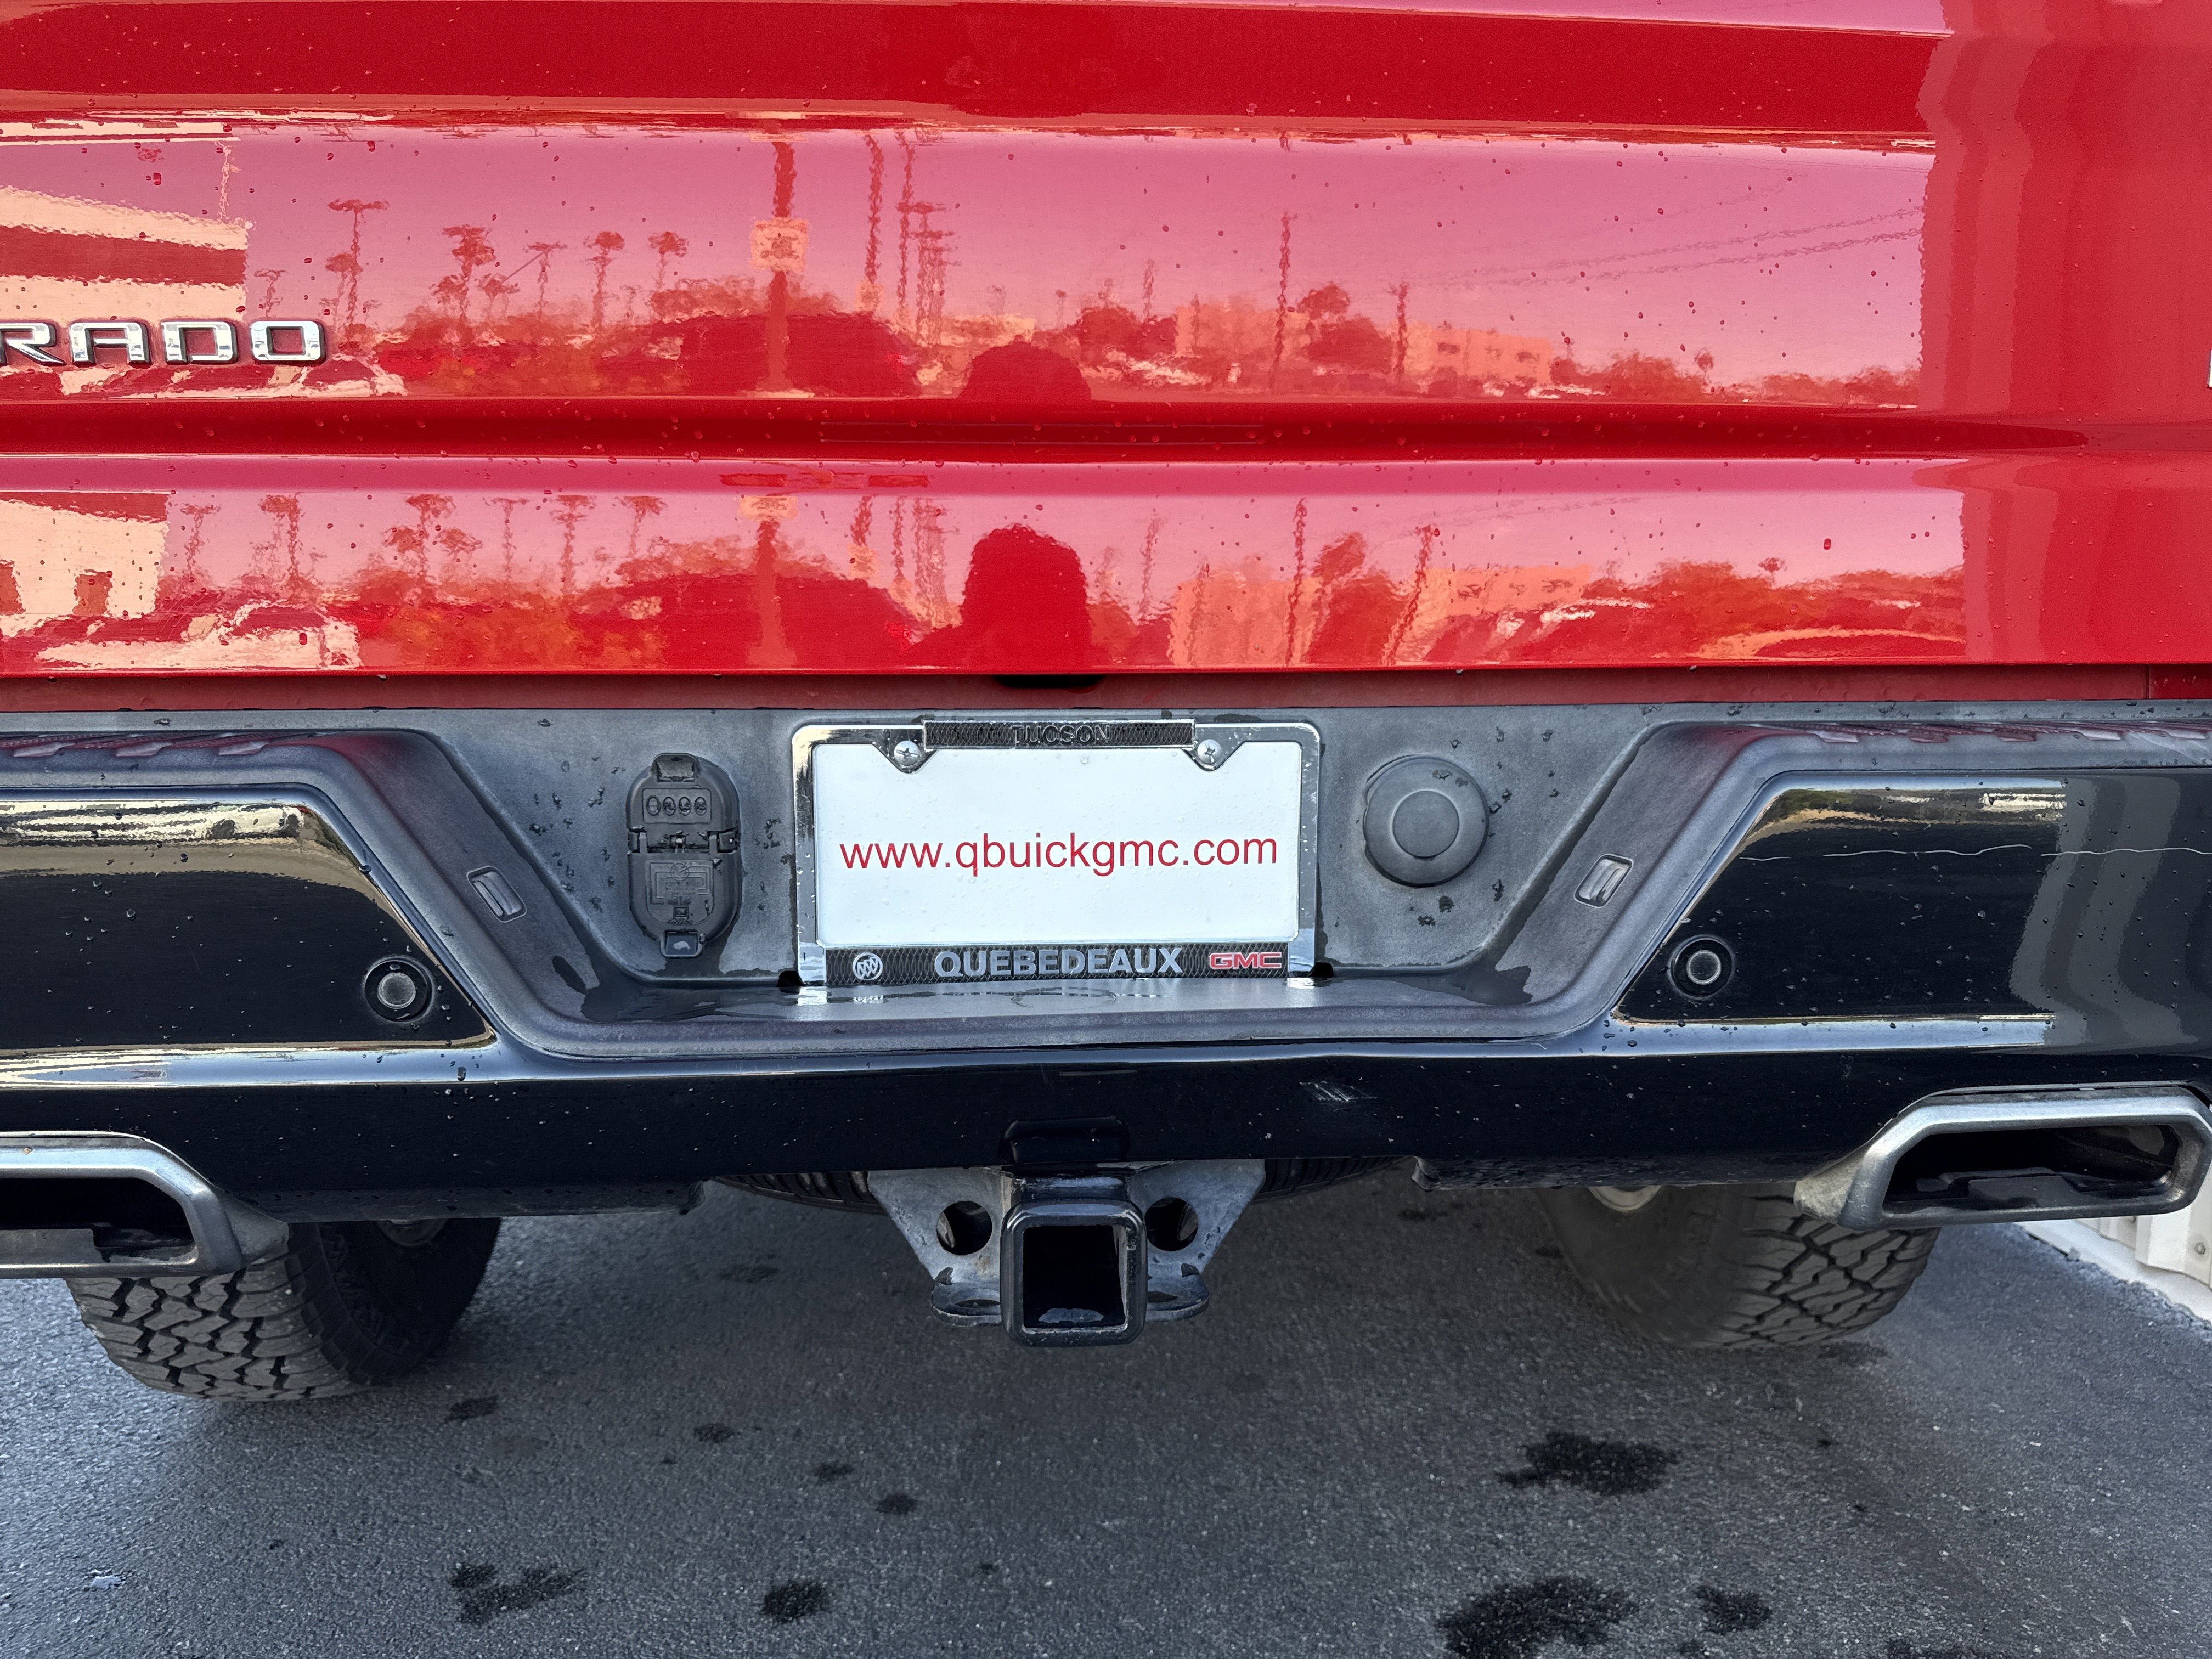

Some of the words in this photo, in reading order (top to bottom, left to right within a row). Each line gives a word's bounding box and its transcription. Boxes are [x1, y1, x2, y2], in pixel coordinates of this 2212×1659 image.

[0, 320, 326, 366] RADO
[1011, 724, 1110, 744] TUCSON
[839, 832, 1277, 877] www.qbuickgmc.com
[934, 947, 1183, 978] QUEBEDEAUX
[1209, 952, 1282, 969] GMC
